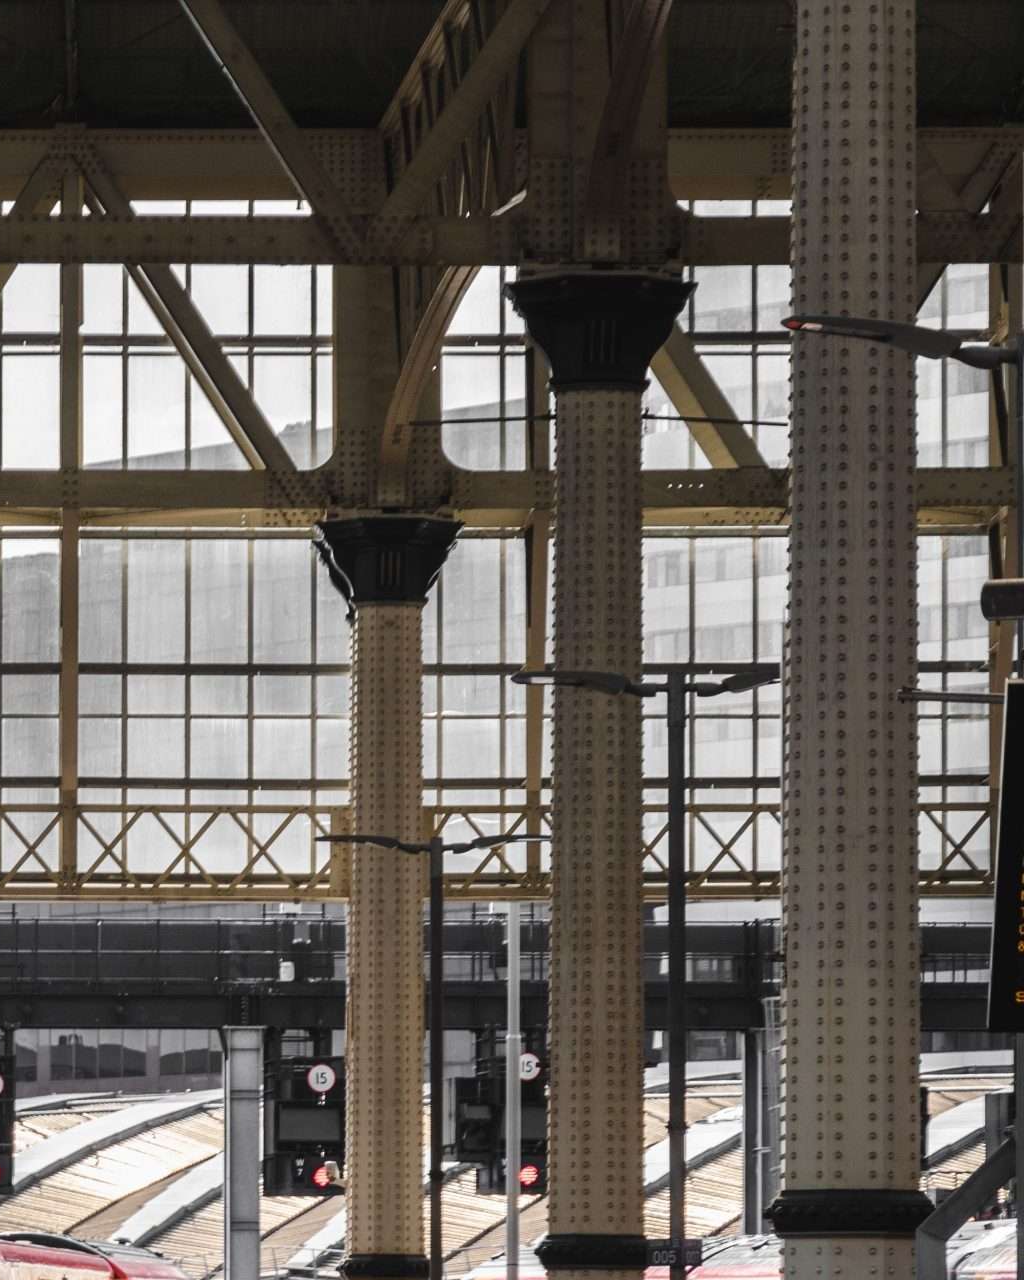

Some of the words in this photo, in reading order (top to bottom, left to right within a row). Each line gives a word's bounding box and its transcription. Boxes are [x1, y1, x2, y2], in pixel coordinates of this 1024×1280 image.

[521, 1061, 534, 1073] 15
[316, 1072, 328, 1085] 15
[653, 1250, 677, 1264] 005
